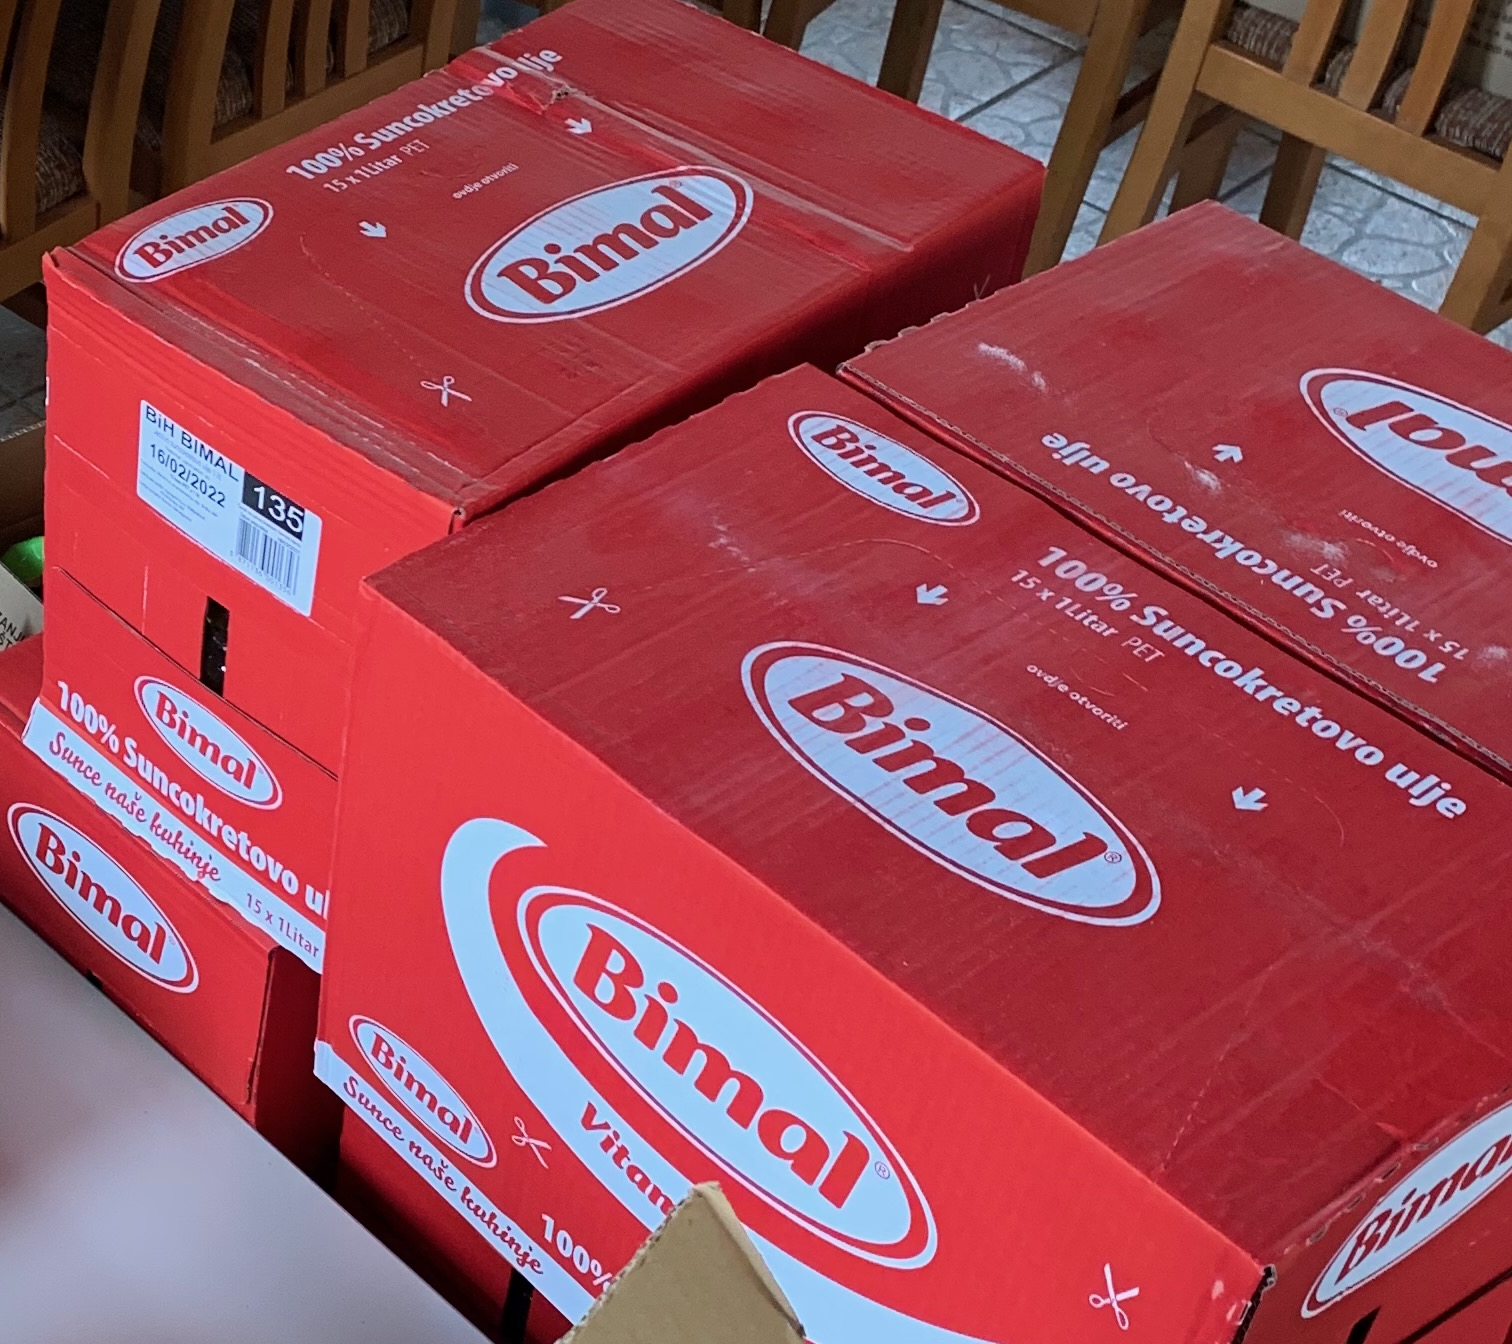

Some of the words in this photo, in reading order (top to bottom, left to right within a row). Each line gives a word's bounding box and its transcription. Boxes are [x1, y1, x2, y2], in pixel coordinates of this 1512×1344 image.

[286, 143, 364, 181] 100%
[364, 65, 518, 152] Suncokretovo
[324, 178, 341, 194] 15
[345, 177, 354, 188] x
[401, 139, 431, 158] PET
[133, 207, 251, 269] Bimal
[497, 182, 715, 305] Bimal
[146, 405, 175, 437] BiH
[181, 431, 239, 482] BIMAL
[150, 443, 226, 508] 16/02/2022
[812, 423, 958, 512] Bimal
[1041, 431, 1104, 476] ulje
[1346, 401, 1512, 488] mal
[253, 486, 303, 533] 135
[1107, 470, 1345, 621] Suncokretovo
[1339, 507, 1396, 549] otvoriti
[1311, 562, 1351, 588] PET
[1394, 539, 1439, 571] ovdje
[1010, 568, 1038, 591] 15
[1039, 586, 1053, 601] x
[1122, 634, 1165, 665] PET
[1344, 610, 1445, 686] 100%
[1425, 630, 1439, 641] x
[1443, 644, 1471, 663] 15
[1026, 661, 1070, 700] ovdje
[1067, 686, 1130, 733] otvoriti
[1037, 544, 1138, 615] 100%
[1131, 602, 1385, 768] Suncokretovo
[1386, 759, 1468, 820] ulje
[154, 690, 255, 791] Bimal
[788, 670, 1110, 880] Bimal
[48, 731, 102, 786] Sunce
[105, 782, 147, 824] naše
[150, 813, 221, 884] kuhinje
[56, 680, 120, 755] 100%
[123, 736, 298, 896] Suncokretovo
[305, 884, 329, 920] ul
[34, 821, 169, 965] Bimal
[245, 892, 262, 917] 15
[265, 910, 274, 924] x
[370, 1031, 474, 1146] Bimal
[573, 922, 872, 1210] Bimal
[342, 1074, 406, 1143] Sunce
[408, 1139, 458, 1194] naše
[459, 1182, 545, 1276] kuhinje
[579, 1101, 675, 1217] Vitam
[1335, 1136, 1512, 1275] Bima
[541, 1213, 616, 1292] 100%
